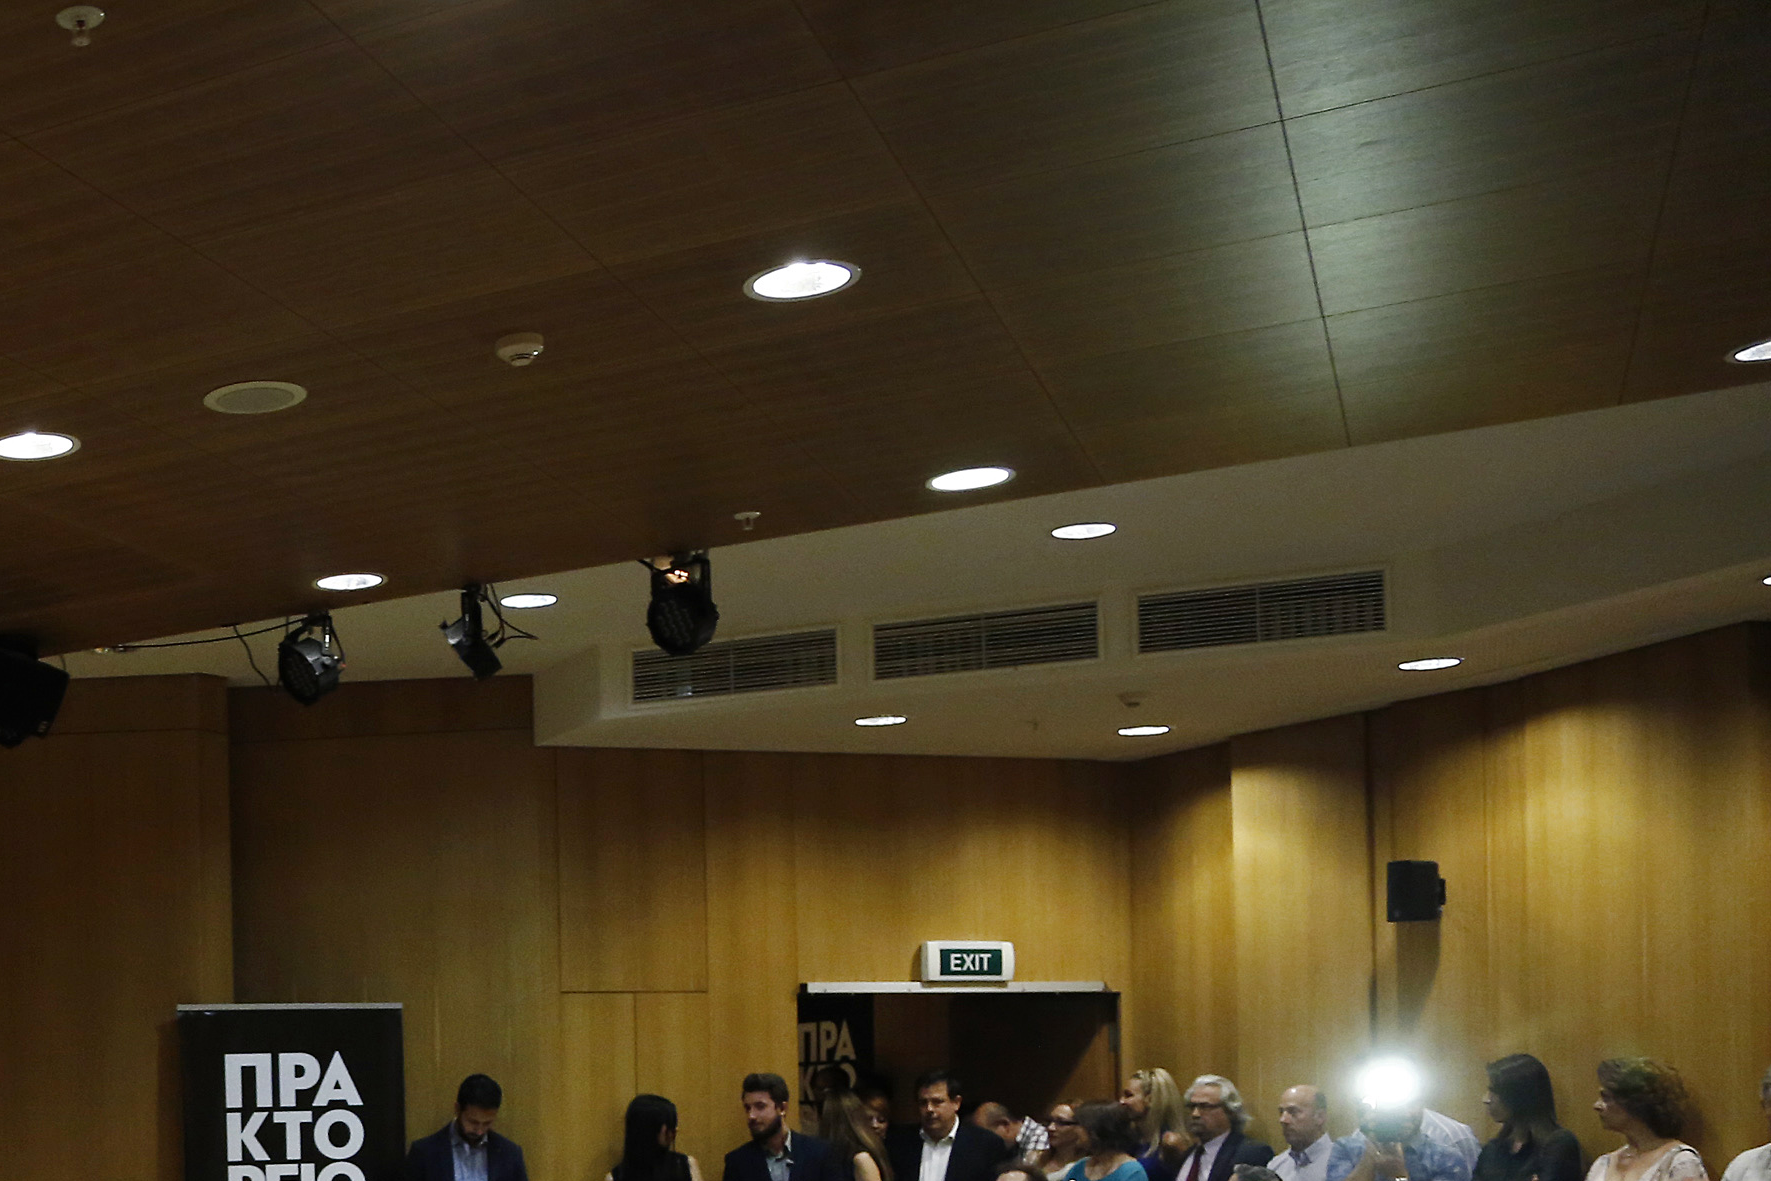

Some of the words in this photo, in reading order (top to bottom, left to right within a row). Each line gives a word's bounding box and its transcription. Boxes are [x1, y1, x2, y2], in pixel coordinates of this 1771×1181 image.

[950, 953, 992, 971] EXIT
[798, 1019, 857, 1062] ΠΡΑ
[224, 1050, 364, 1109] ΠΡΑ
[226, 1109, 365, 1162] ΚΤΟ
